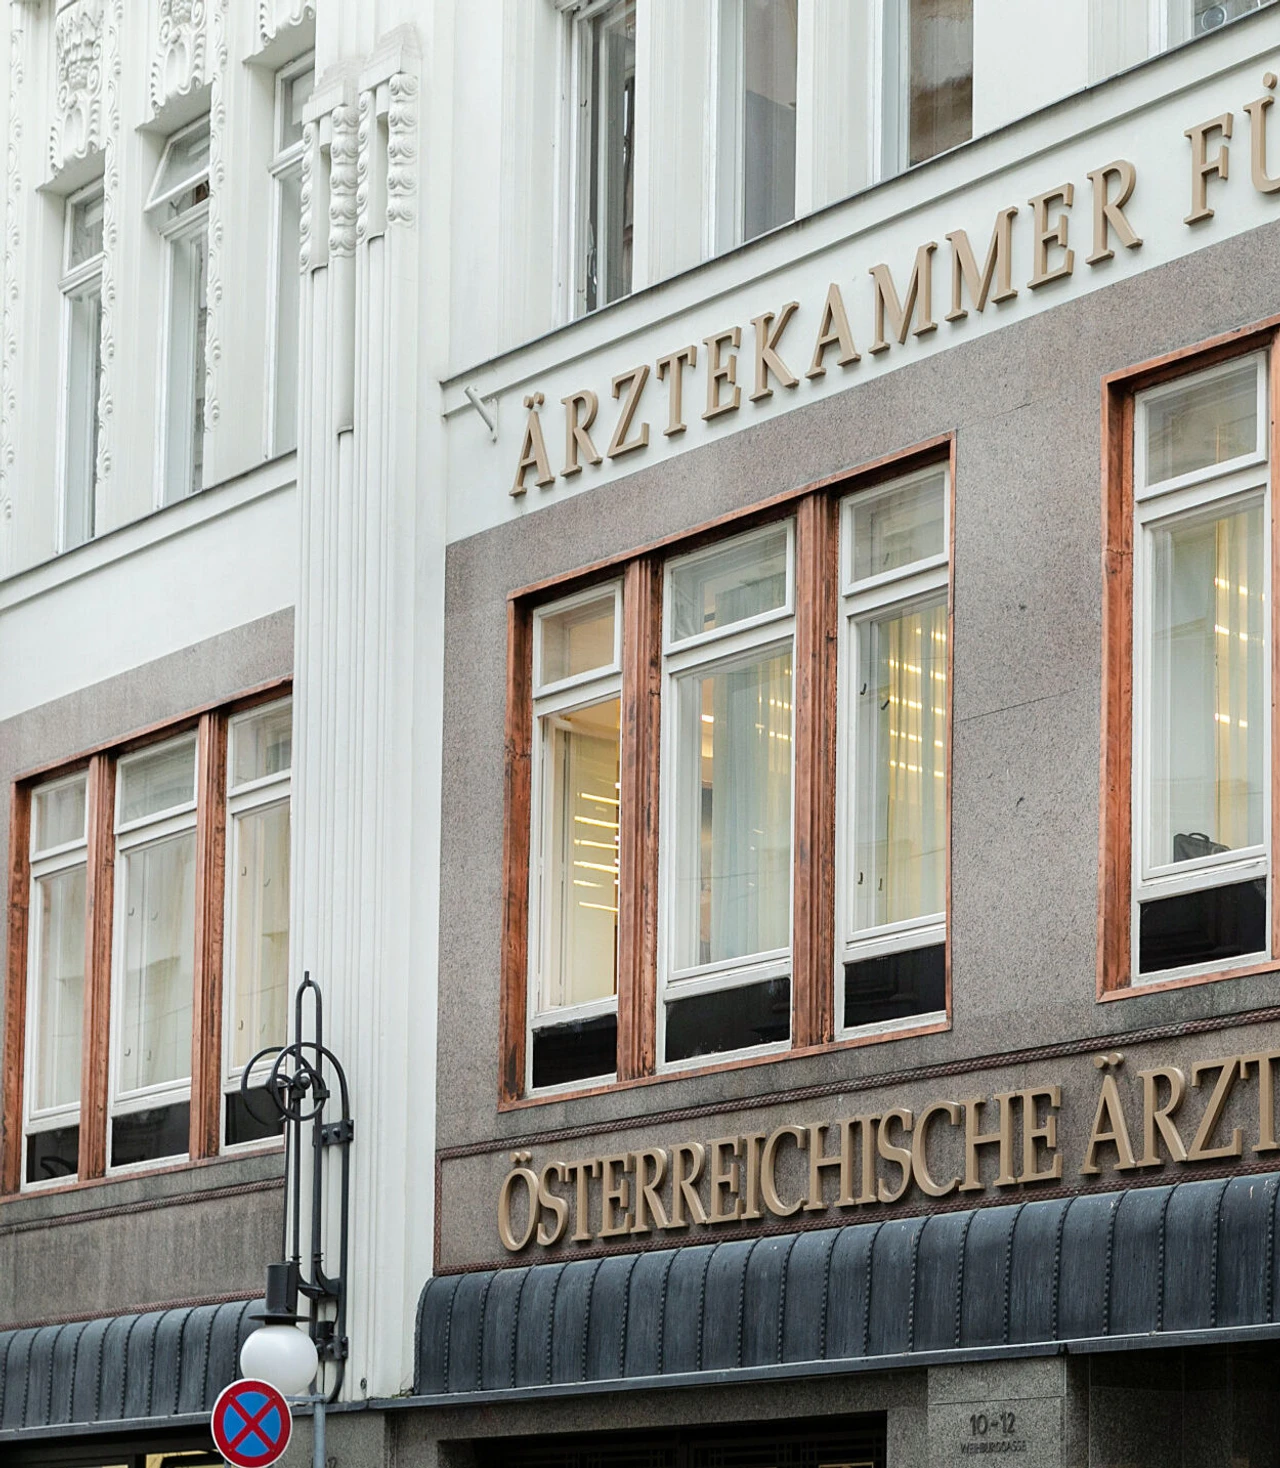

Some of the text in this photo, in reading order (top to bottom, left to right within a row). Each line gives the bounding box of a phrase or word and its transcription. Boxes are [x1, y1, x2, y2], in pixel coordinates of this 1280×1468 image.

[508, 159, 1144, 498] ÄRZTEKAMMER
[499, 1085, 1063, 1252] ÖSTERREICHISCHE
[969, 1411, 1016, 1436] 10-12
